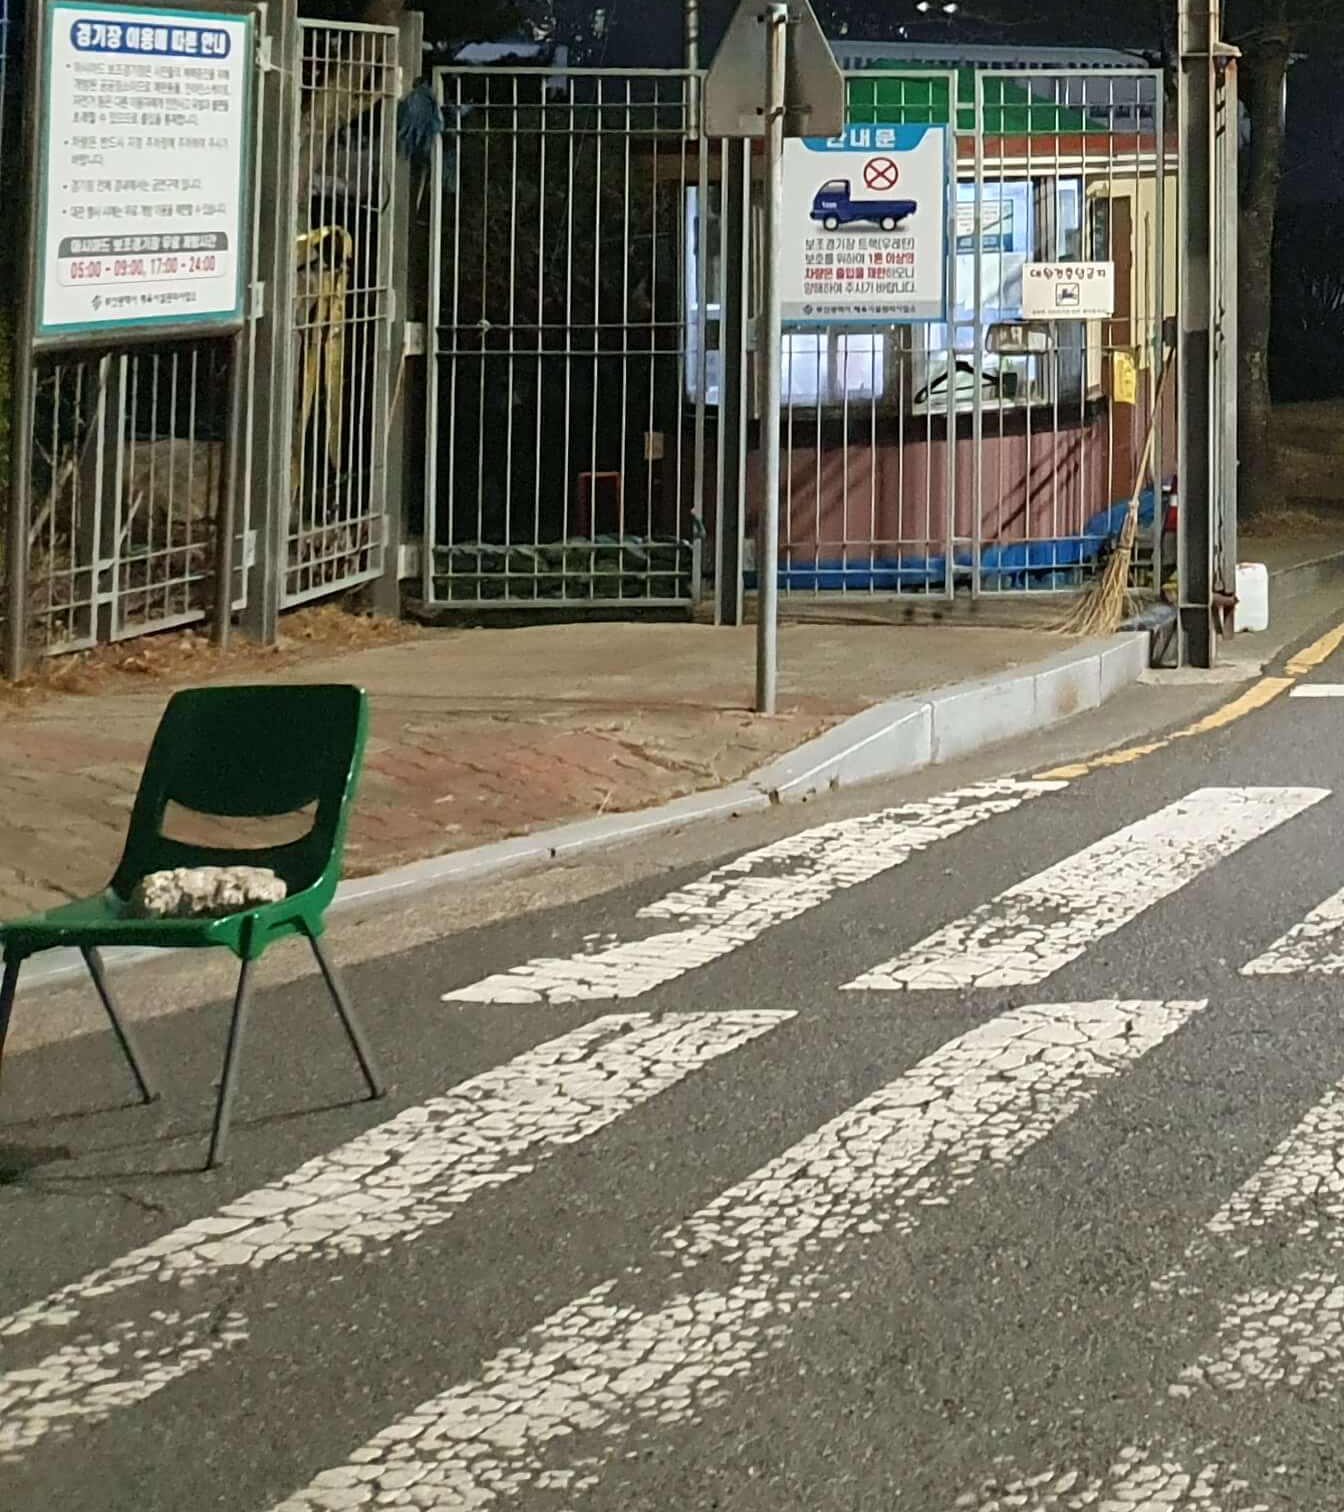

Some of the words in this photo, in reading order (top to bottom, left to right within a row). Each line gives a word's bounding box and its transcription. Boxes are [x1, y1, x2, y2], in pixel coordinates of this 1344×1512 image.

[76, 22, 122, 49] 경기장
[201, 32, 226, 55] 안내
[805, 238, 855, 250] 보조경기장
[805, 252, 834, 265] 보호를
[837, 252, 865, 265] 위하여
[868, 252, 883, 265] 1톤
[886, 252, 915, 265] 이상의
[71, 261, 101, 279] 05:00
[151, 257, 178, 275] 17:00
[189, 255, 216, 272] 24:00
[805, 267, 833, 279] 차량은
[836, 267, 865, 279] 출입을
[868, 267, 915, 279] 제한하오니
[845, 282, 874, 294] 주시기
